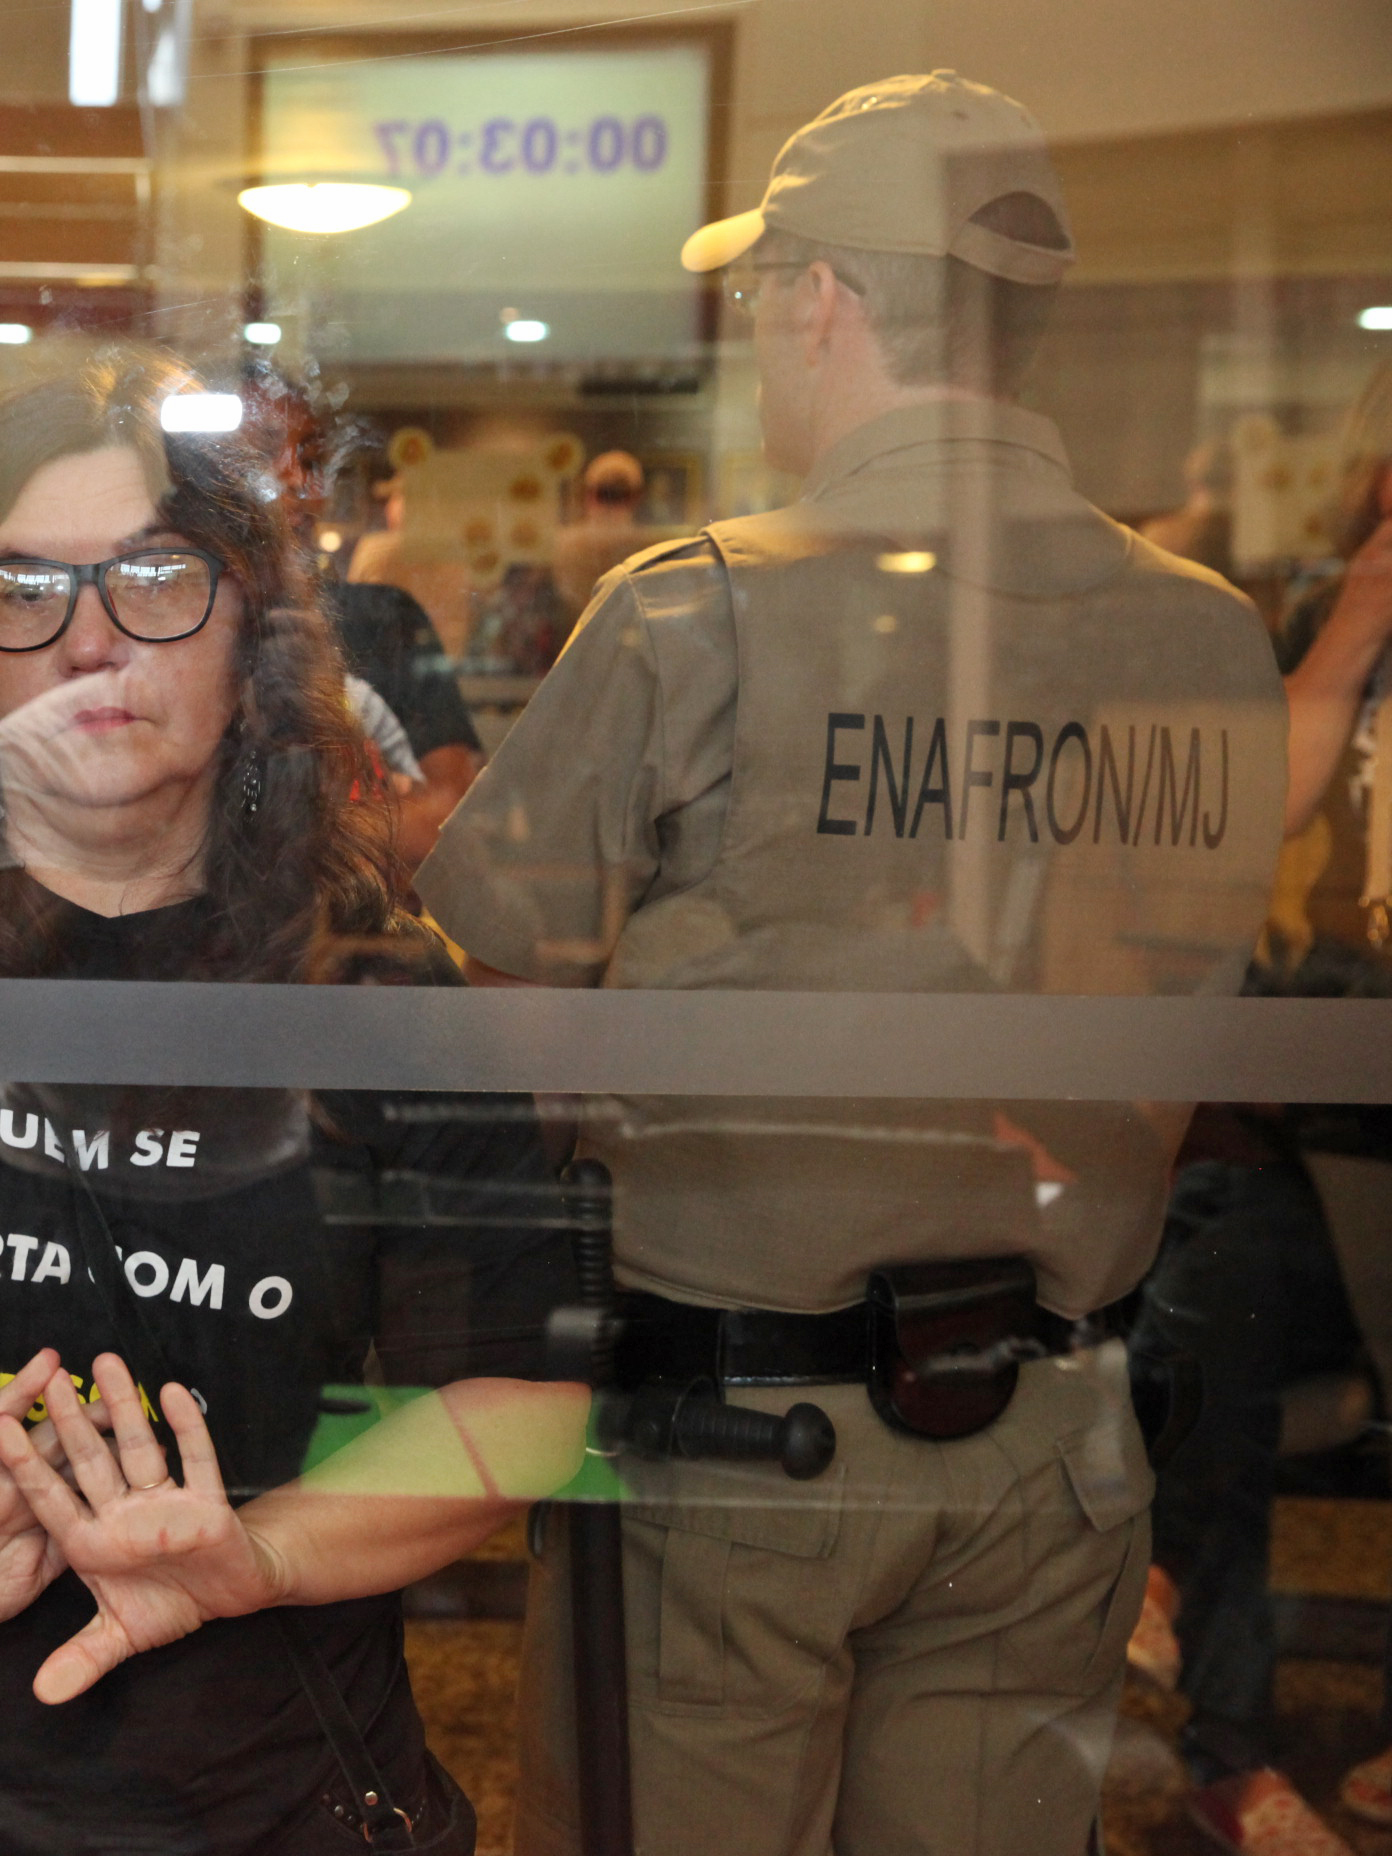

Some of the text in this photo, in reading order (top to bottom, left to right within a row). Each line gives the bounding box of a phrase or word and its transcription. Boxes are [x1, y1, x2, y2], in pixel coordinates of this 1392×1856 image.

[816, 712, 1229, 850] ENAFRON/MJ
[129, 1127, 201, 1168] SE
[87, 1245, 225, 1310] OM
[247, 1275, 293, 1320] O
